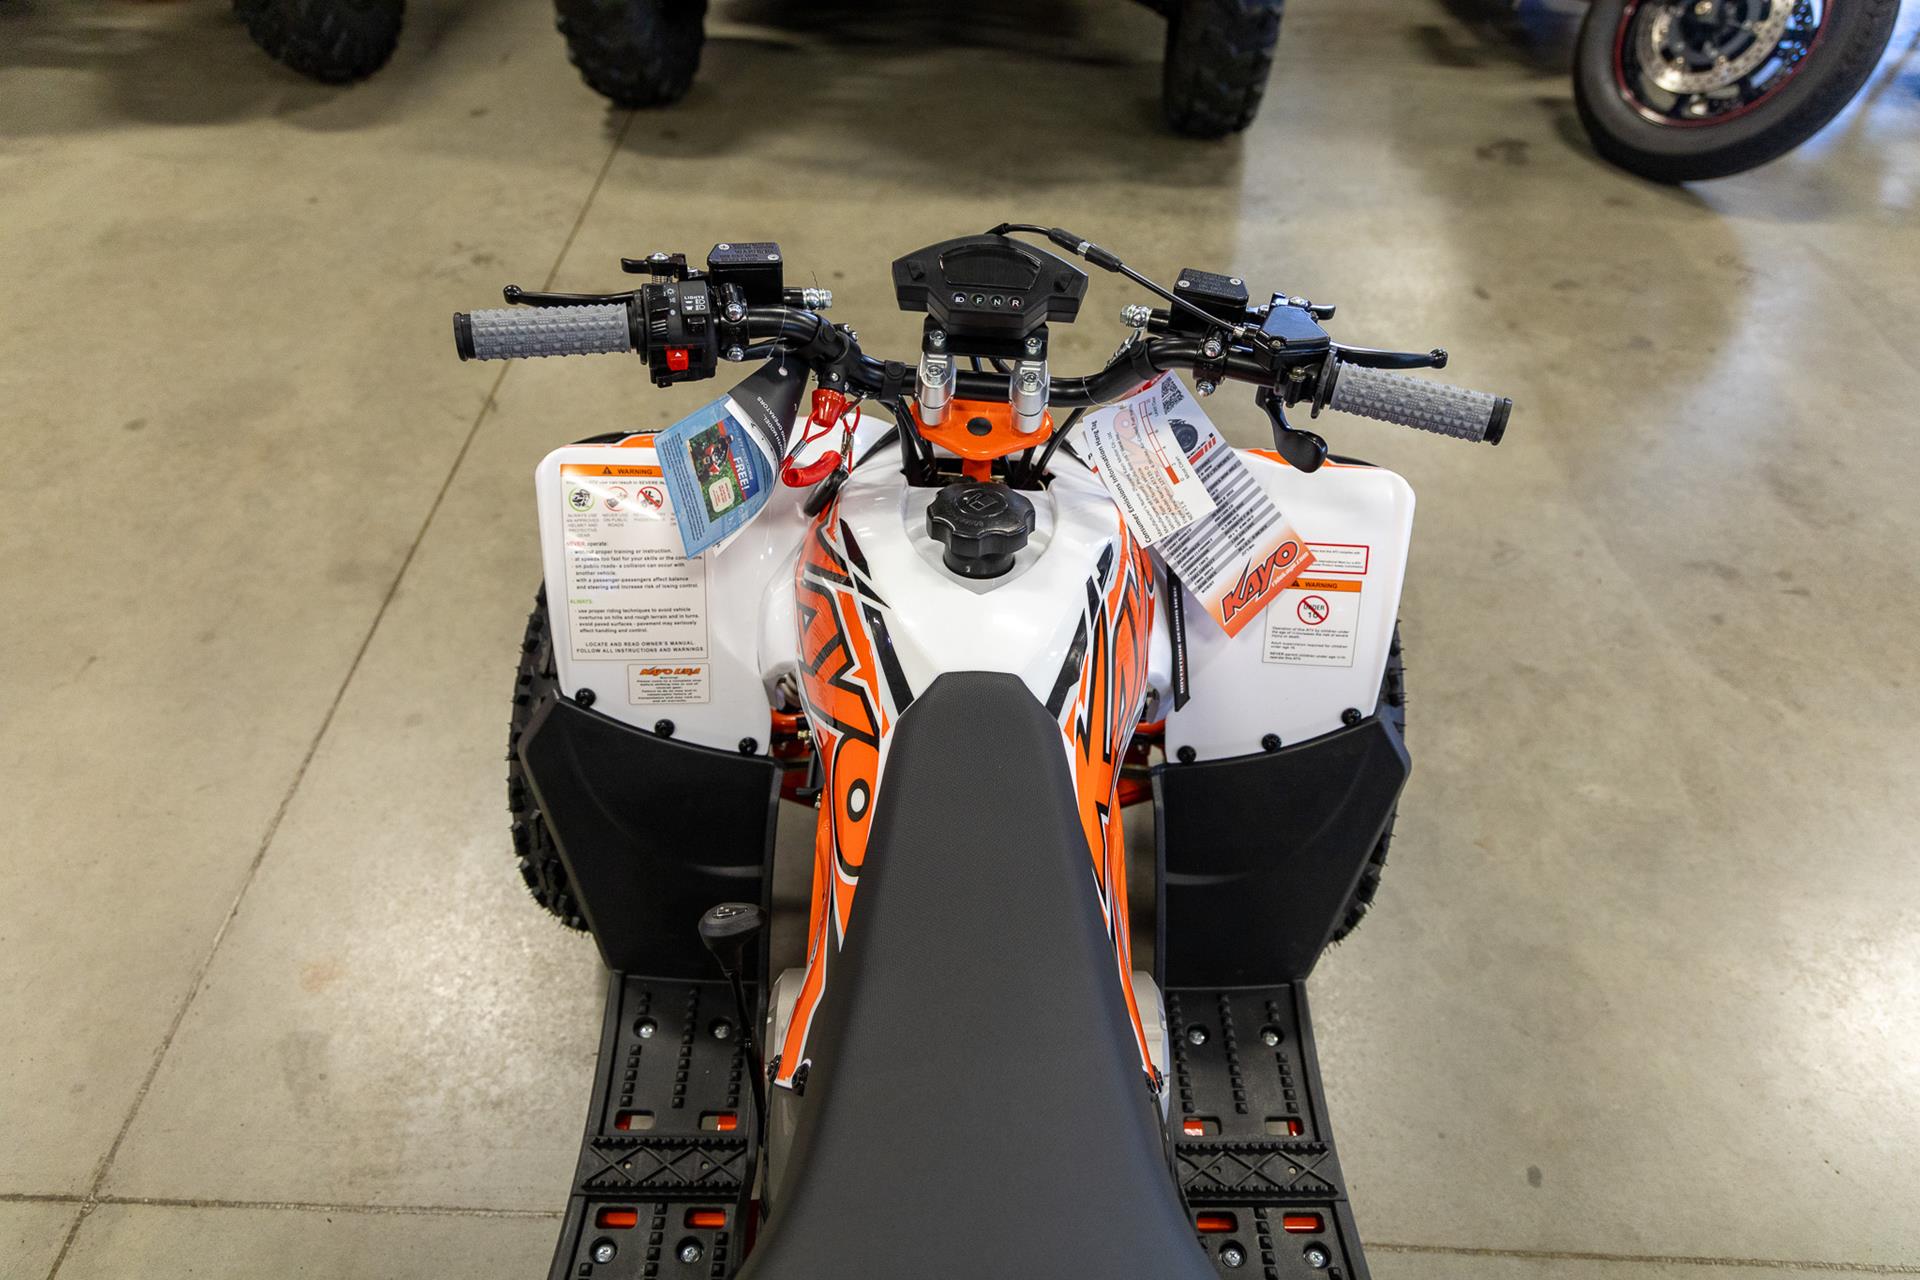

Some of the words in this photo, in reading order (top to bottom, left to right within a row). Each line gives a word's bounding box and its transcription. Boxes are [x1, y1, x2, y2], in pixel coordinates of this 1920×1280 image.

[756, 395, 783, 430] OPERATORS
[1093, 429, 1101, 446] Hang
[732, 456, 750, 490] FREE!
[1096, 445, 1118, 483] Information
[1114, 482, 1135, 513] Emissions
[1131, 512, 1151, 543] Consumer
[1222, 541, 1298, 622] KAYO
